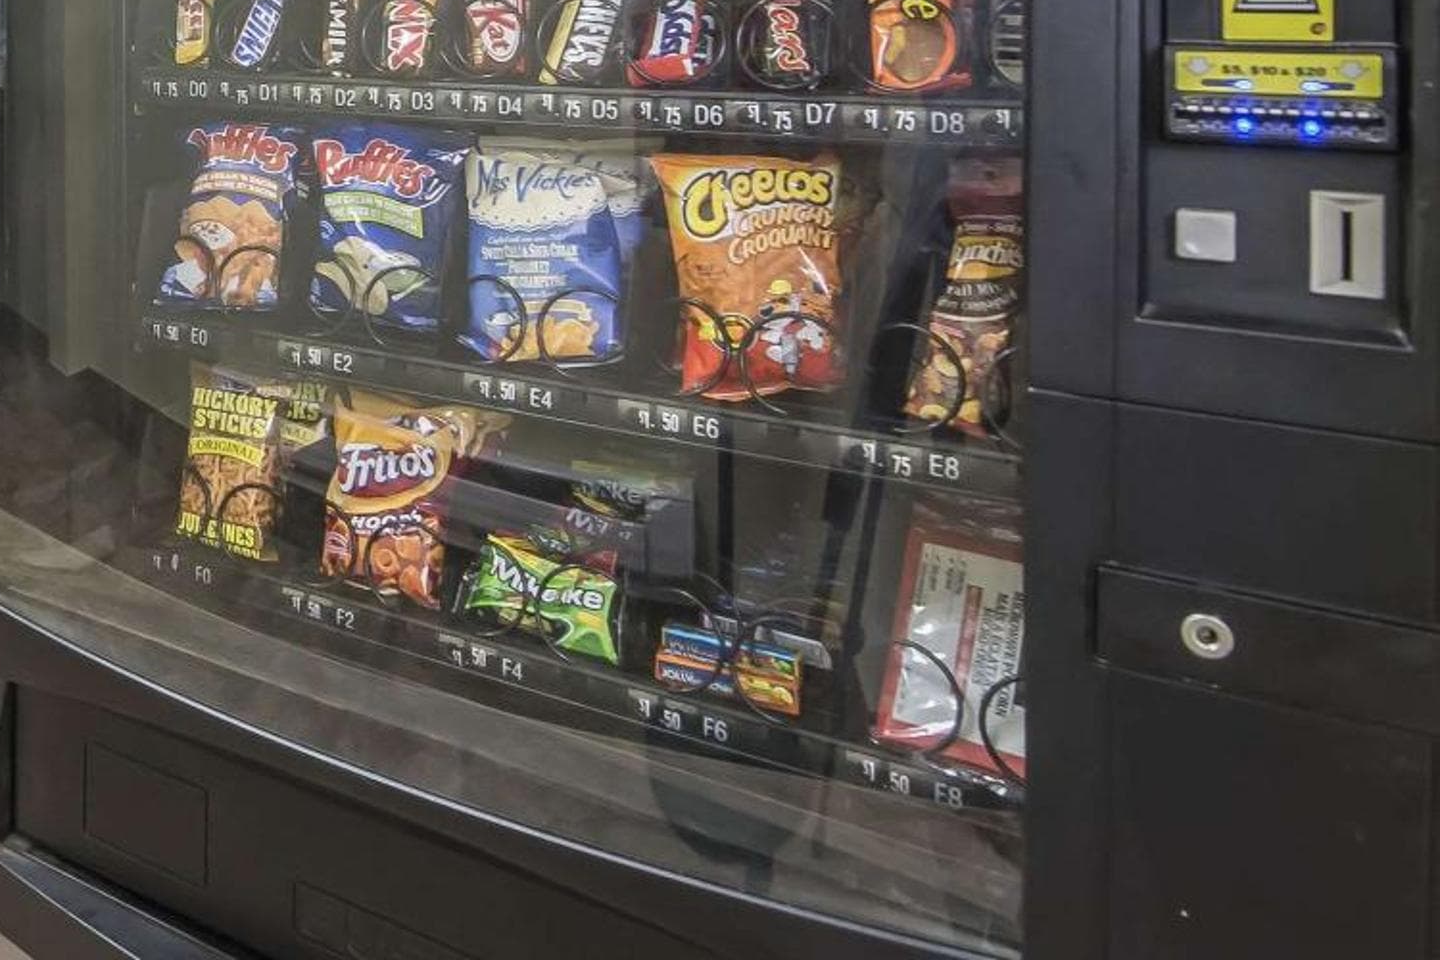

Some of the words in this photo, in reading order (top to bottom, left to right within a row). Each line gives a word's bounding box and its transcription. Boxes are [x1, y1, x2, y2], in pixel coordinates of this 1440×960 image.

[1295, 65, 1328, 77] $20
[188, 80, 208, 97] D0
[259, 82, 279, 101] D1
[334, 88, 356, 106] D2
[411, 91, 434, 111] D3
[498, 97, 522, 116] D4
[592, 99, 618, 120] D5
[694, 105, 723, 127] D6
[805, 102, 836, 125] D7
[931, 111, 965, 134] D8
[312, 138, 436, 198] Ruffles
[682, 169, 834, 239] Cheetos
[735, 207, 835, 236] CRUNCHY
[728, 228, 835, 264] CROQUANT
[191, 327, 208, 346] E0
[334, 354, 353, 373] E2
[193, 387, 278, 420] HICKORY
[529, 390, 552, 409] E4
[193, 408, 266, 440] STICKS
[693, 418, 720, 439] E6
[194, 441, 262, 463] ORIGINAL
[928, 457, 960, 480] E8
[195, 566, 211, 585] F0
[335, 608, 355, 629] F2
[502, 658, 523, 680] F4
[703, 717, 728, 742] F6
[934, 782, 963, 809] F8
